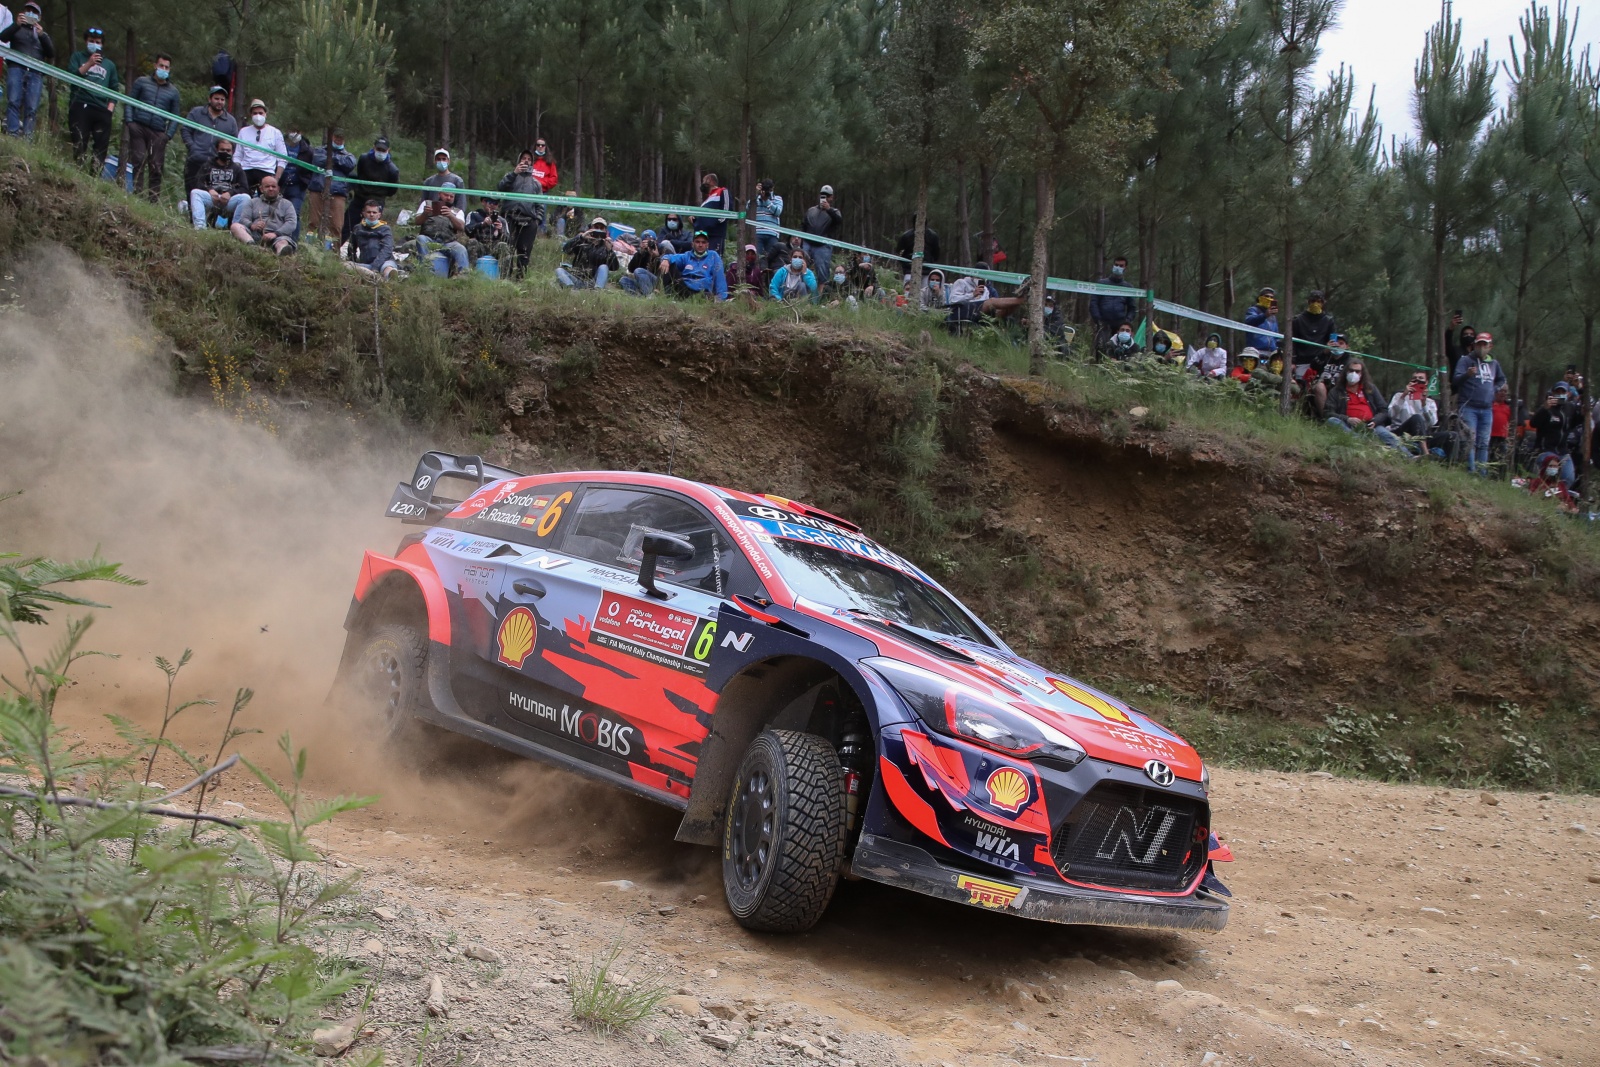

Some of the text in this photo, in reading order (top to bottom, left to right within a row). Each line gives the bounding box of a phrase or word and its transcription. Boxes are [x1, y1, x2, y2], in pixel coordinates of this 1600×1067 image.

[493, 491, 534, 507] D. Sordo
[478, 507, 522, 525] B. Rozada
[537, 491, 573, 537] 6
[714, 504, 773, 580] motorsport.hyundai.com
[599, 616, 621, 628] vodafone
[625, 613, 687, 641] Portugal
[630, 608, 645, 617] rally
[608, 639, 619, 648] FIA
[618, 641, 633, 652] World
[632, 645, 646, 658] Rally
[646, 651, 681, 670] Championship
[670, 642, 683, 652] 2021
[693, 621, 718, 661] 6
[509, 691, 557, 722] HYUNDAI
[560, 704, 634, 756] MOBIS
[1125, 742, 1176, 760] SYSTEMS
[724, 778, 741, 860] SCORPION
[964, 816, 1006, 836] HYUNDAI
[975, 830, 1020, 861] WIA
